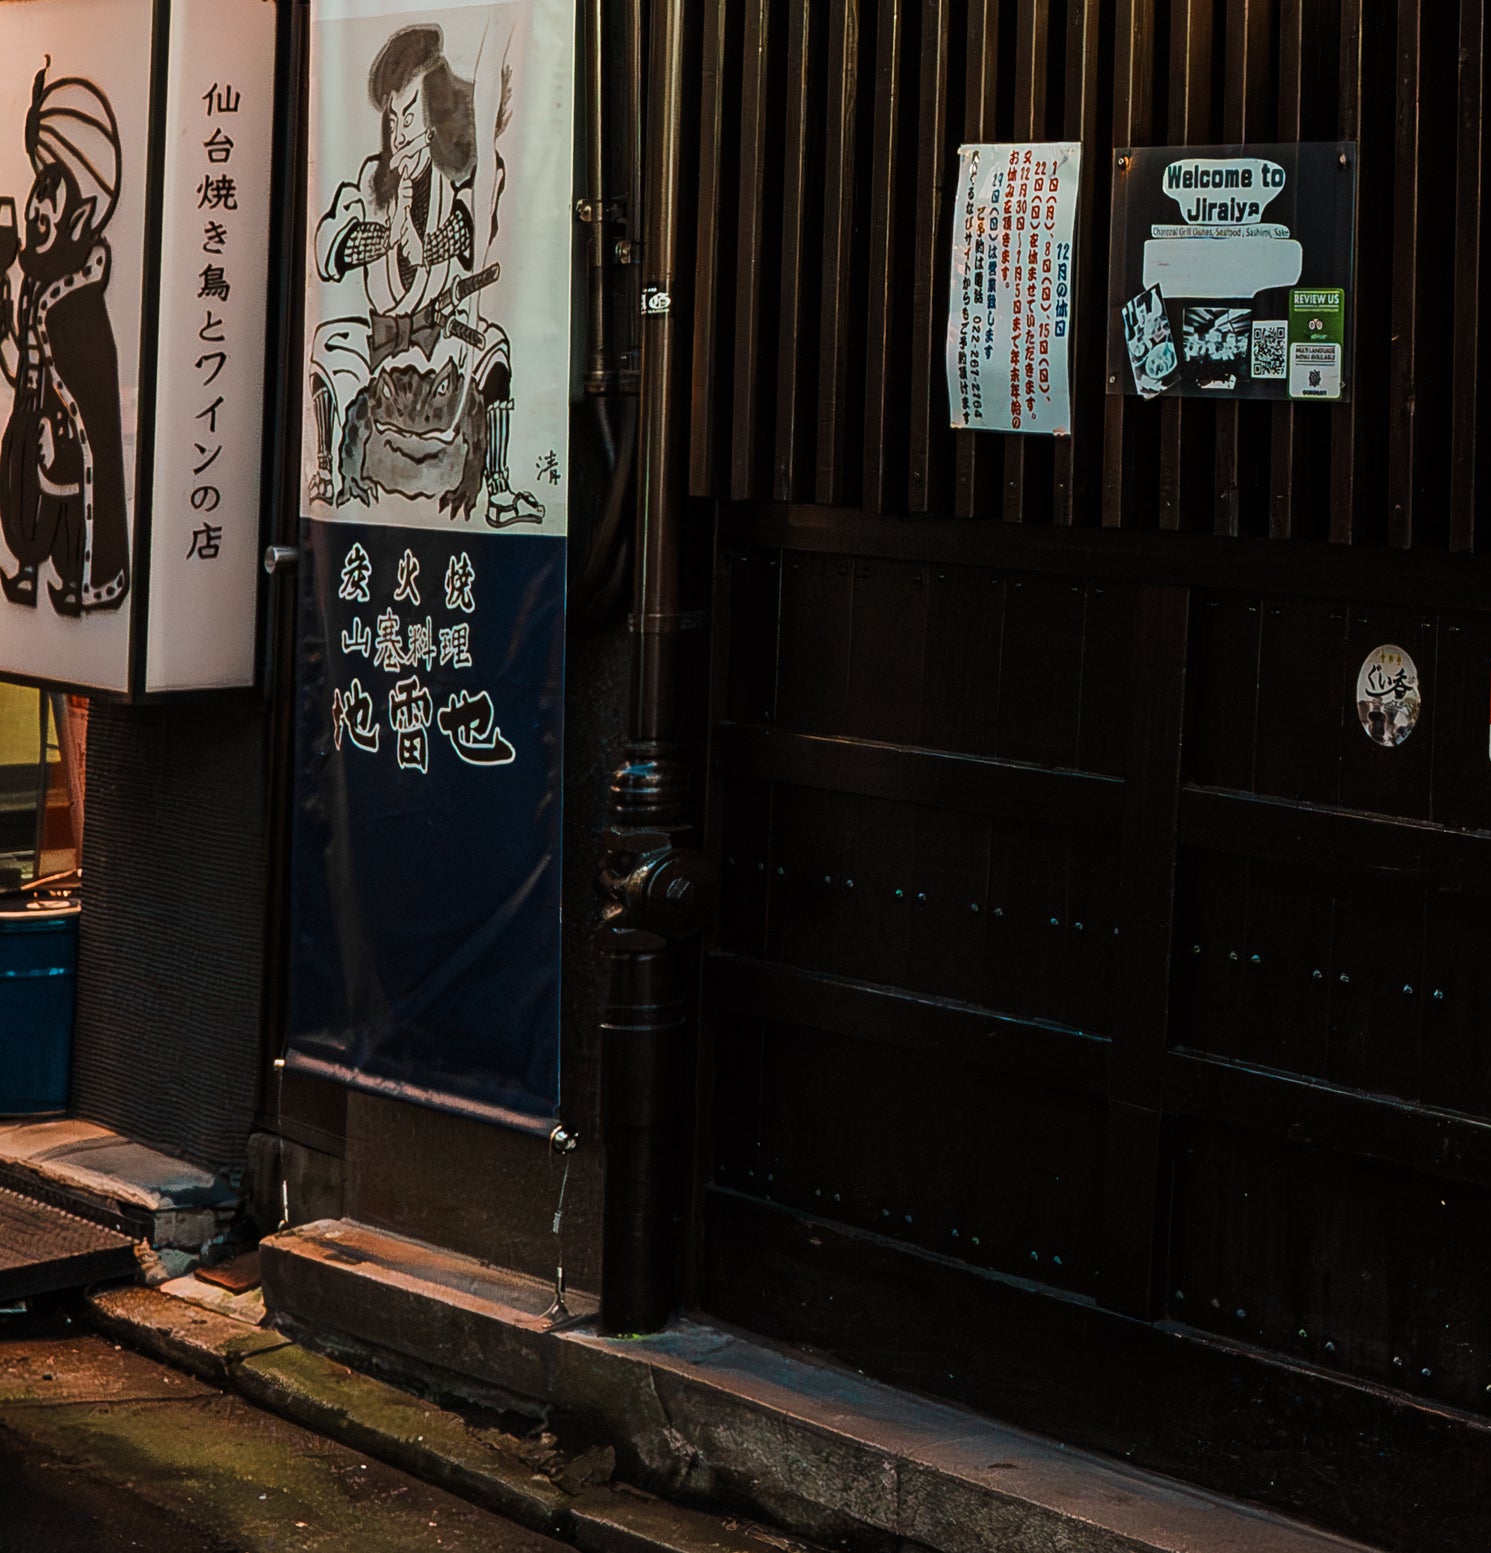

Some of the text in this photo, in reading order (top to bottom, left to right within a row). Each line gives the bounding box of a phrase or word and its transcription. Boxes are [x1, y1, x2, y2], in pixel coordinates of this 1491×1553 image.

[1167, 163, 1285, 190] Welcome to
[1187, 197, 1260, 223] Jiraiya
[185, 82, 242, 561] 仙台焼き鳥とワインの店
[1054, 242, 1071, 338] 12月の休日
[1294, 294, 1340, 305] REVIEW US
[341, 607, 473, 673] 山塞料理
[332, 674, 517, 775] 地雷也
